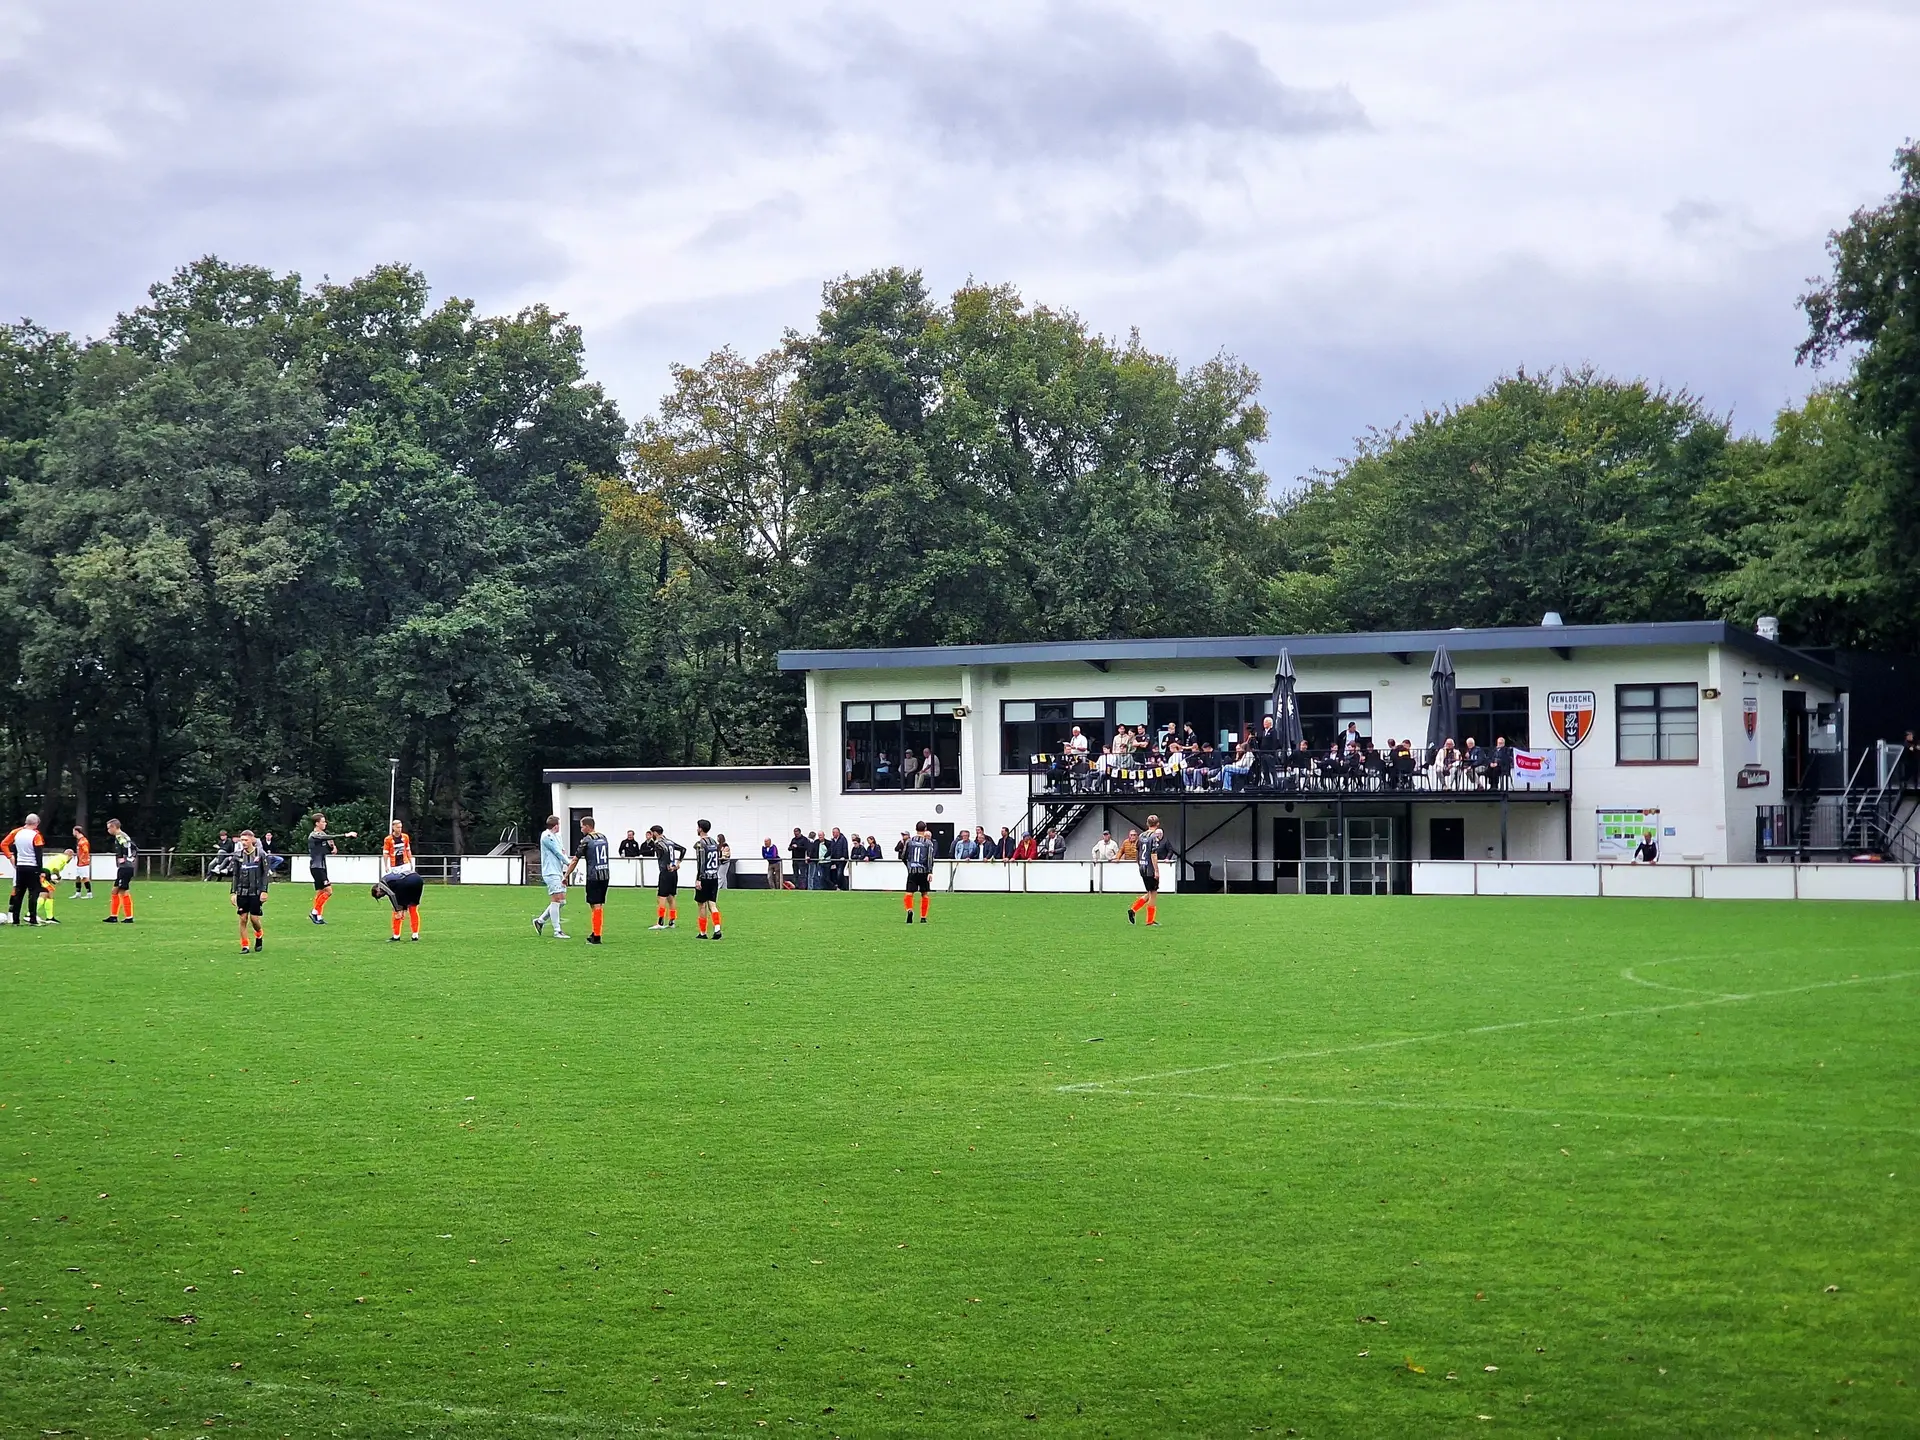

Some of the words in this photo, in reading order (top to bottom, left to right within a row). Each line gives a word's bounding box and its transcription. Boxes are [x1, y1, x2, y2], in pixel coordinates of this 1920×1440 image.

[1550, 695, 1592, 703] VENLOSCHE
[595, 845, 607, 864] 14
[706, 850, 718, 869] 23
[914, 846, 921, 863] 11
[1141, 843, 1147, 860] 2
